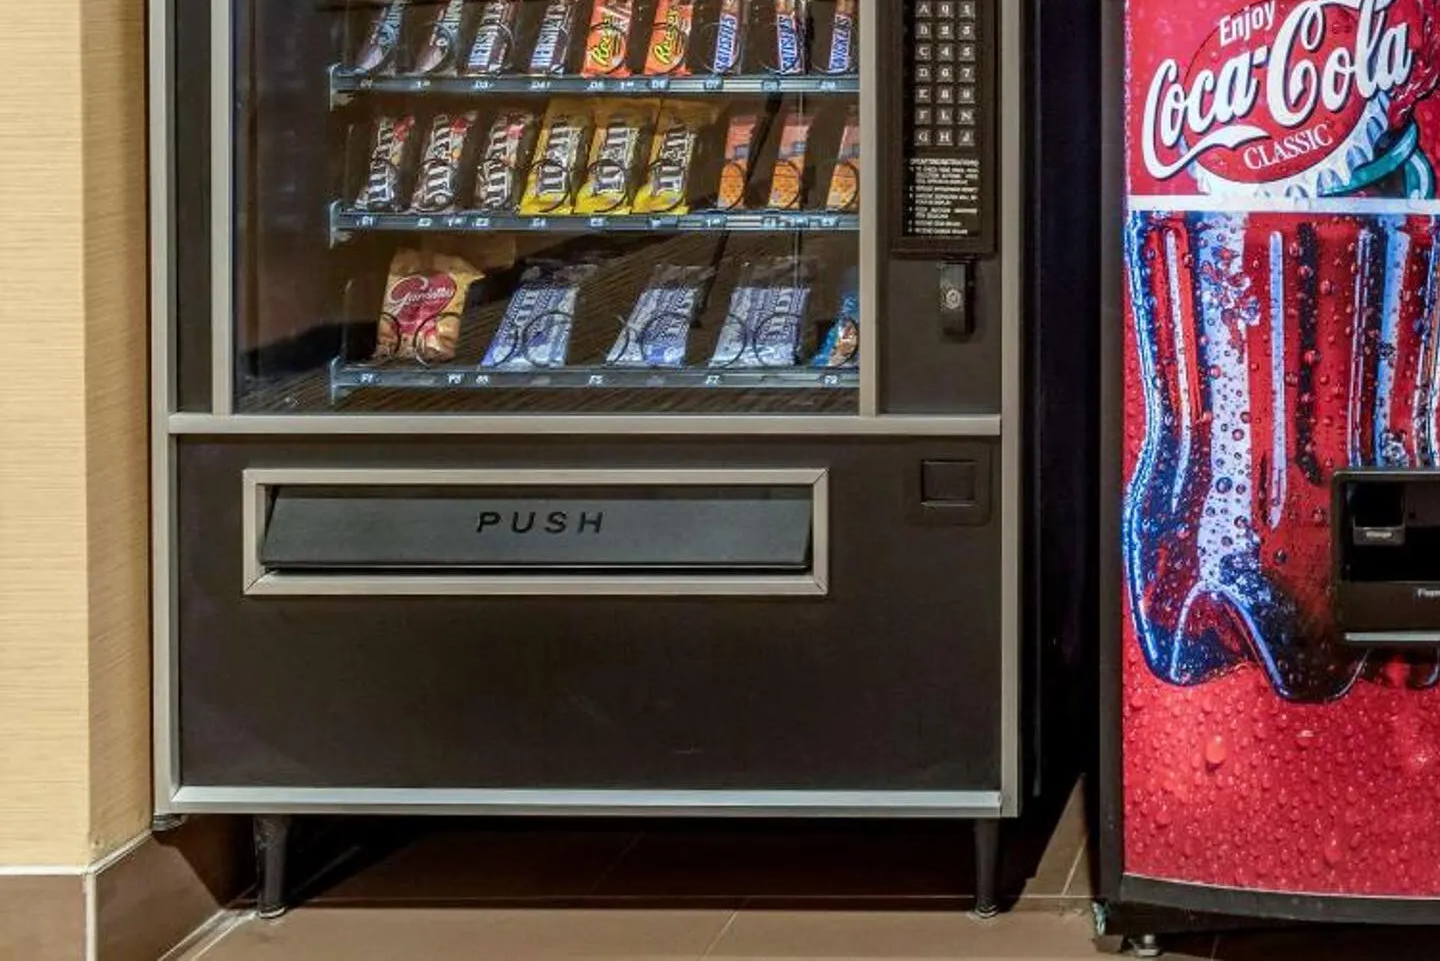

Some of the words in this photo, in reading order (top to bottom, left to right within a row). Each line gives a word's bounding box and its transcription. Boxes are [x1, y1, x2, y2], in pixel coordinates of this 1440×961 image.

[1219, 0, 1276, 47] Enjoy
[1243, 124, 1334, 170] CLASSIC
[476, 510, 604, 534] PUSH
